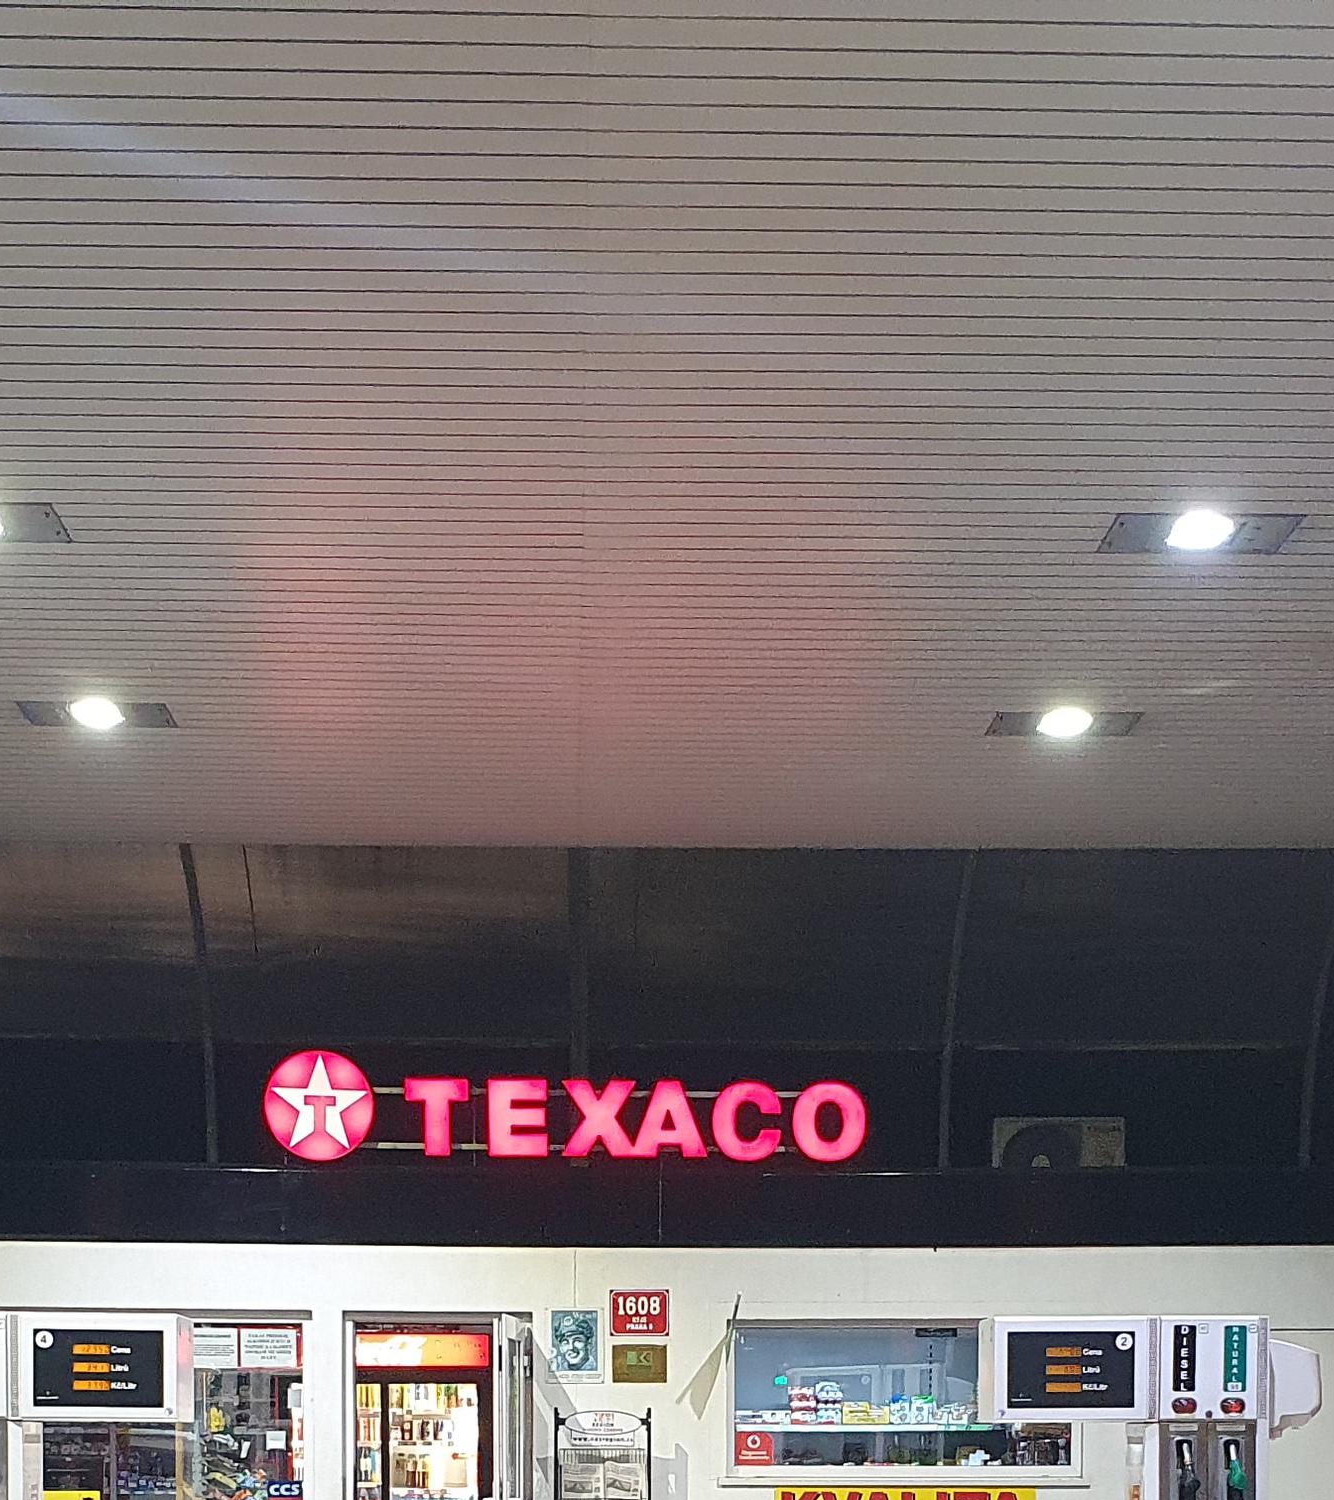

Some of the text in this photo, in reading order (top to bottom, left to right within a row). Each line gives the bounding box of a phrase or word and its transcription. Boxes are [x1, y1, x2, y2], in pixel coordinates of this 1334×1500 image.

[404, 1078, 867, 1162] TEXACO
[617, 1295, 661, 1316] 1608
[40, 1335, 47, 1344] 4
[1120, 1337, 1128, 1347] 2
[1180, 1325, 1190, 1392] DIESEL
[1231, 1326, 1240, 1382] NATURAL
[269, 1483, 300, 1496] CCS
